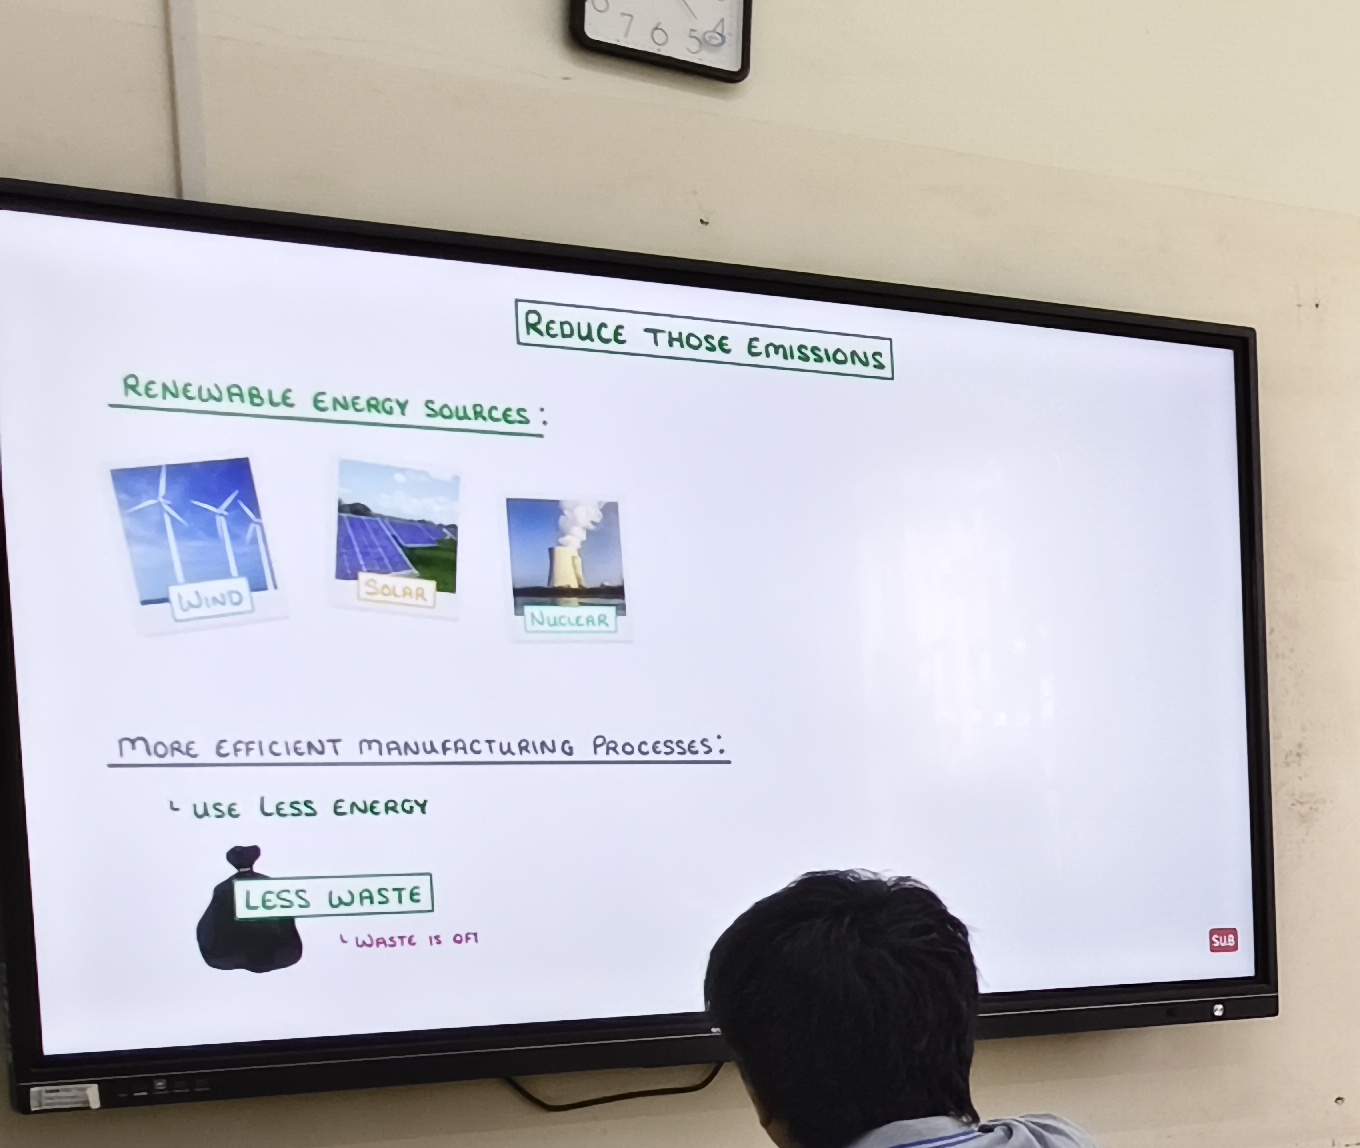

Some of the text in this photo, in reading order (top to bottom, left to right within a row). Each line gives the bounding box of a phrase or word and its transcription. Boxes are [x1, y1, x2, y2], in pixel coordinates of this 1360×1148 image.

[620, 11, 634, 38] 7
[650, 22, 669, 47] 6
[686, 28, 703, 54] 5
[525, 309, 886, 370] REDUCE THOSE EMISSIONS
[122, 373, 549, 426] RENEWABLE ENERGY SOURCES:
[177, 589, 244, 613] WIND
[364, 578, 428, 602] SOLAR
[530, 610, 610, 629] NUCLEAR
[118, 734, 726, 758] MORE EFFICIENT MANUFACTURING PROCESSES:
[192, 796, 429, 819] USE LESS ENERGY
[245, 885, 422, 911] LESS WASTE
[355, 933, 417, 948] WASTE
[428, 934, 443, 946] IS
